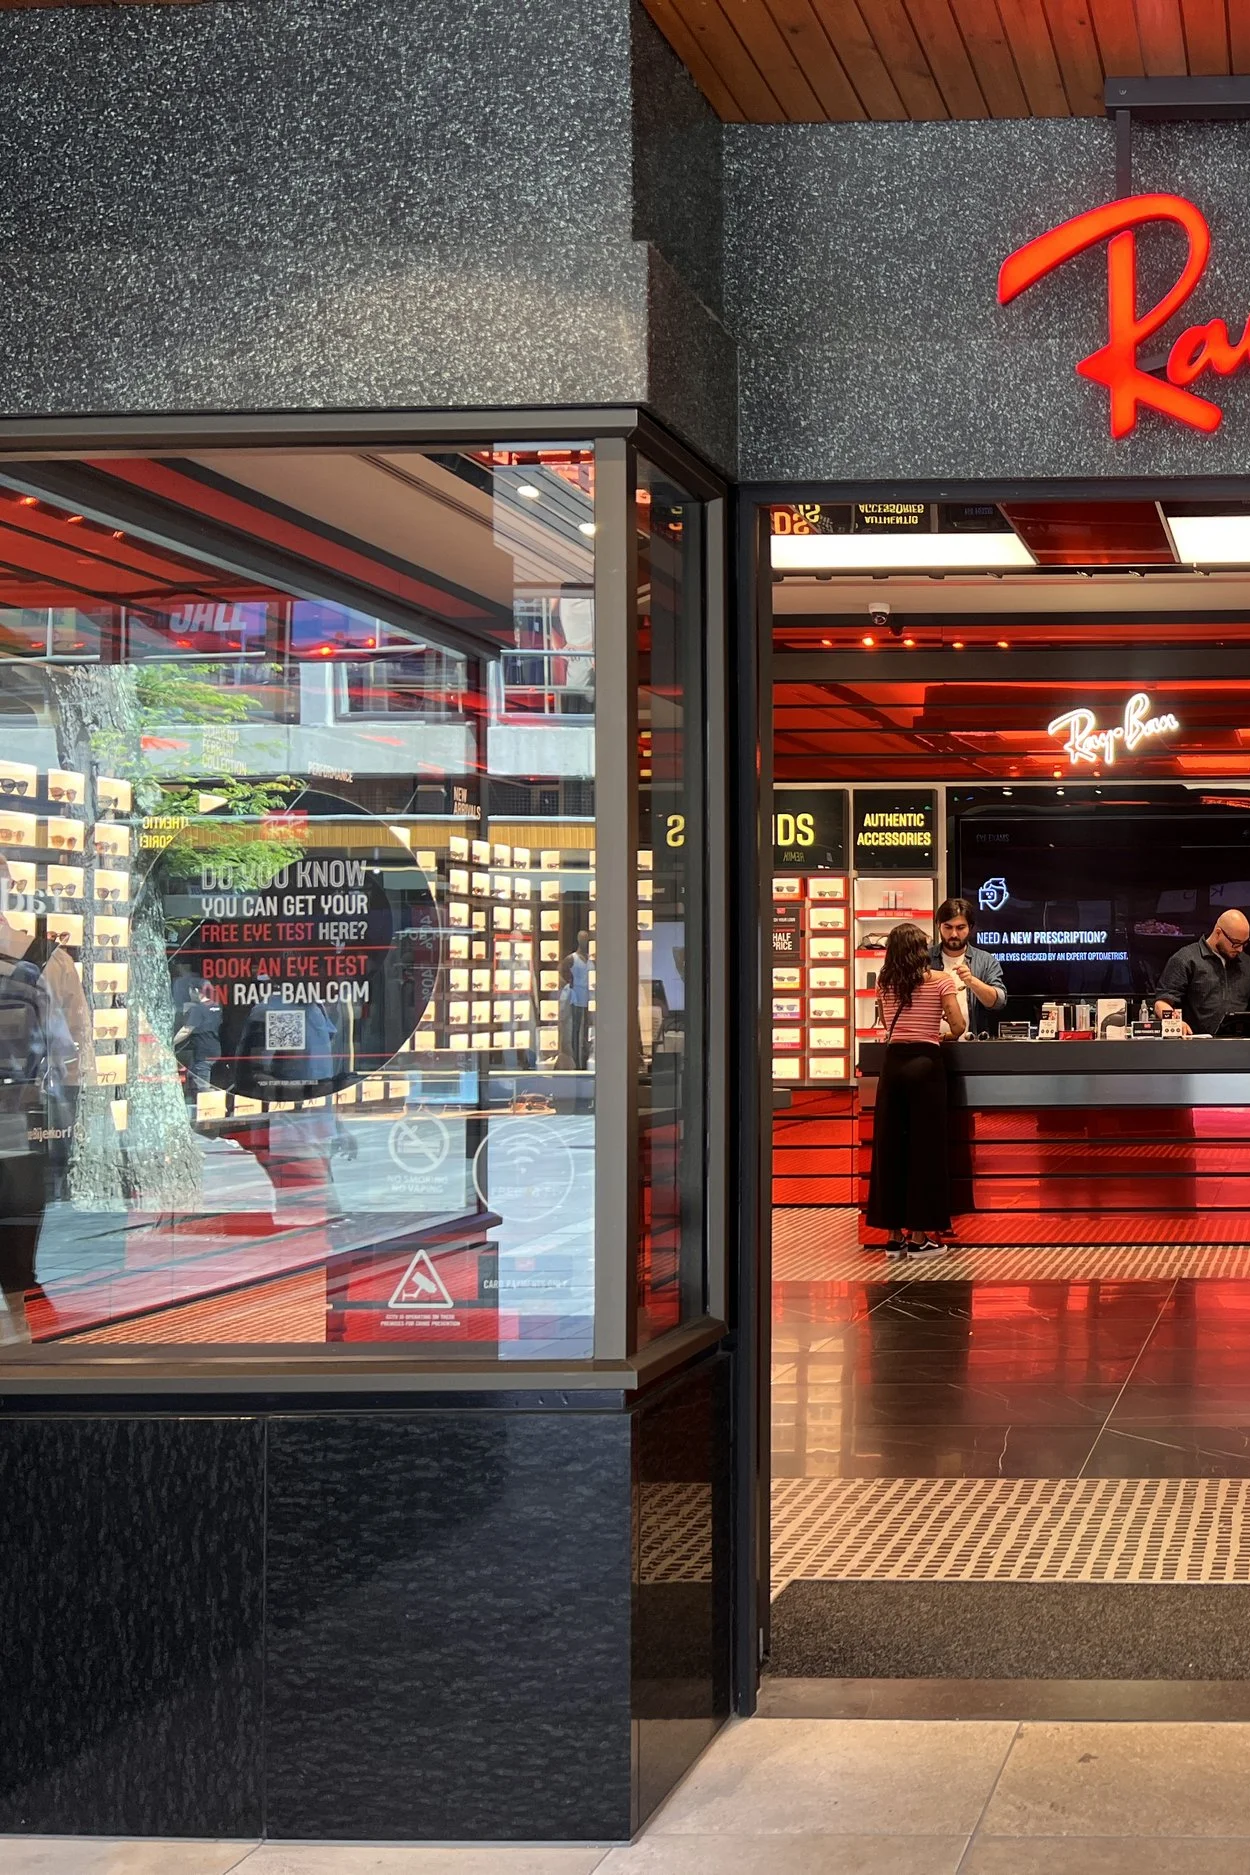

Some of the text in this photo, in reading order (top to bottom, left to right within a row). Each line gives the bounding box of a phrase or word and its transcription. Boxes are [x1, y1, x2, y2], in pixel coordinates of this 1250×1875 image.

[453, 785, 468, 802] NEW
[863, 813, 924, 827] AUTHENTIC
[857, 832, 932, 846] ACCESSORIES
[202, 859, 367, 890] DO YOU KNOW
[202, 894, 368, 917] YOU CAN GET YOUR
[202, 921, 368, 942] FREE EYE TEST HERE?
[772, 932, 791, 941] HALF
[976, 931, 1107, 944] NEED A NEW PRESCRIPTION?
[1006, 953, 1020, 961] EYES
[1021, 953, 1047, 961] CHECKED
[1048, 953, 1056, 961] BY
[1057, 953, 1066, 961] AN
[1066, 952, 1087, 961] EXPERT
[1088, 952, 1129, 961] OPTOMETRIST.
[202, 955, 368, 979] BOOK AN EYE TEST
[202, 981, 370, 1005] ON RAY-BAN.COM
[483, 1279, 504, 1289] CARD
